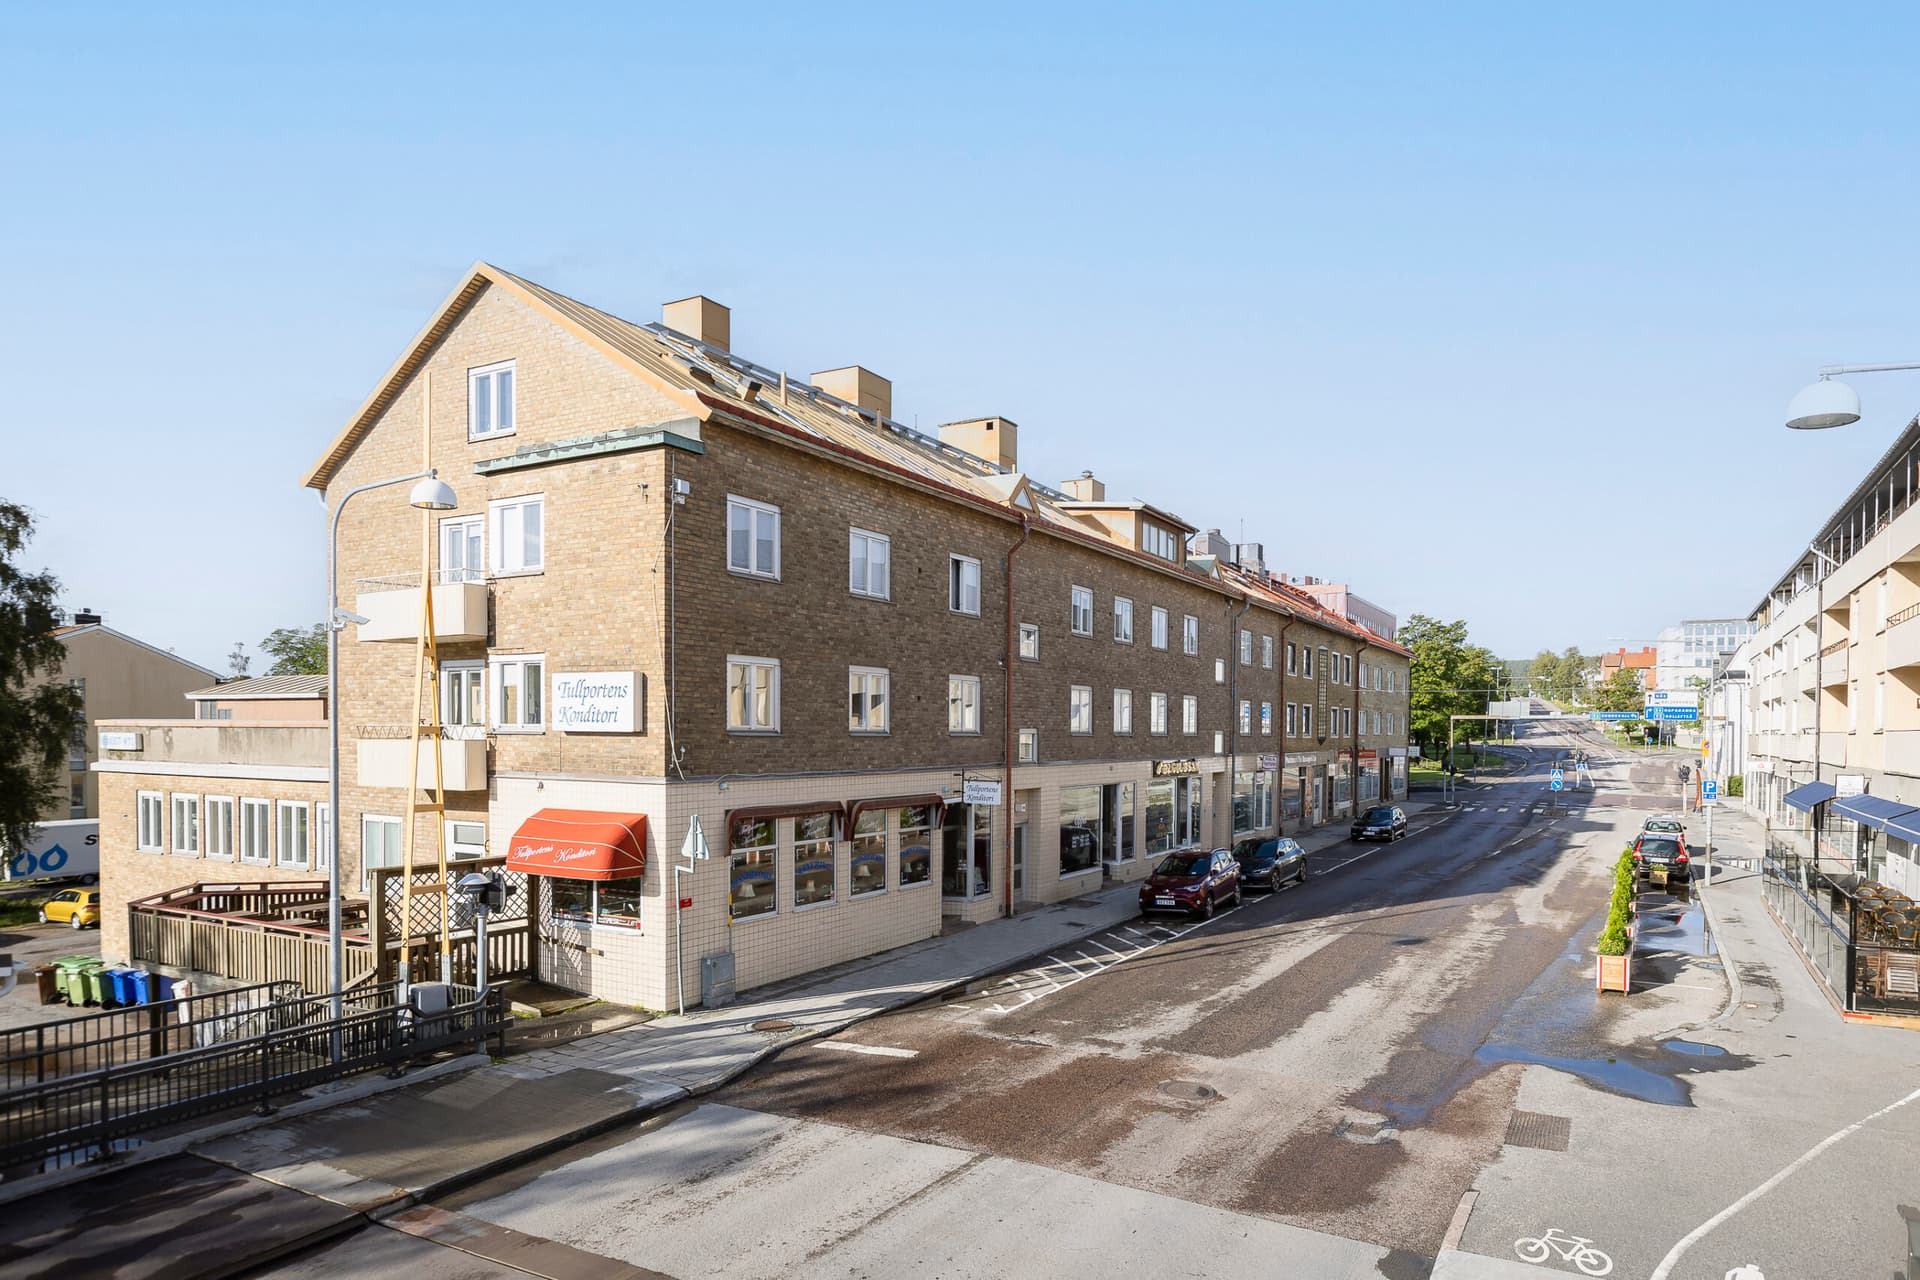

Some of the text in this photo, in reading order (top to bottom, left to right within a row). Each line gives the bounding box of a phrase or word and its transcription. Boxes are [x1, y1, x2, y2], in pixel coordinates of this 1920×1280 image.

[558, 679, 628, 705] Tullportens
[559, 704, 618, 726] Konditori
[966, 784, 998, 795] Tullportens
[1706, 782, 1715, 791] P
[966, 794, 994, 802] Konditori
[84, 834, 99, 846] S
[512, 844, 598, 863] Tullportens Konditori
